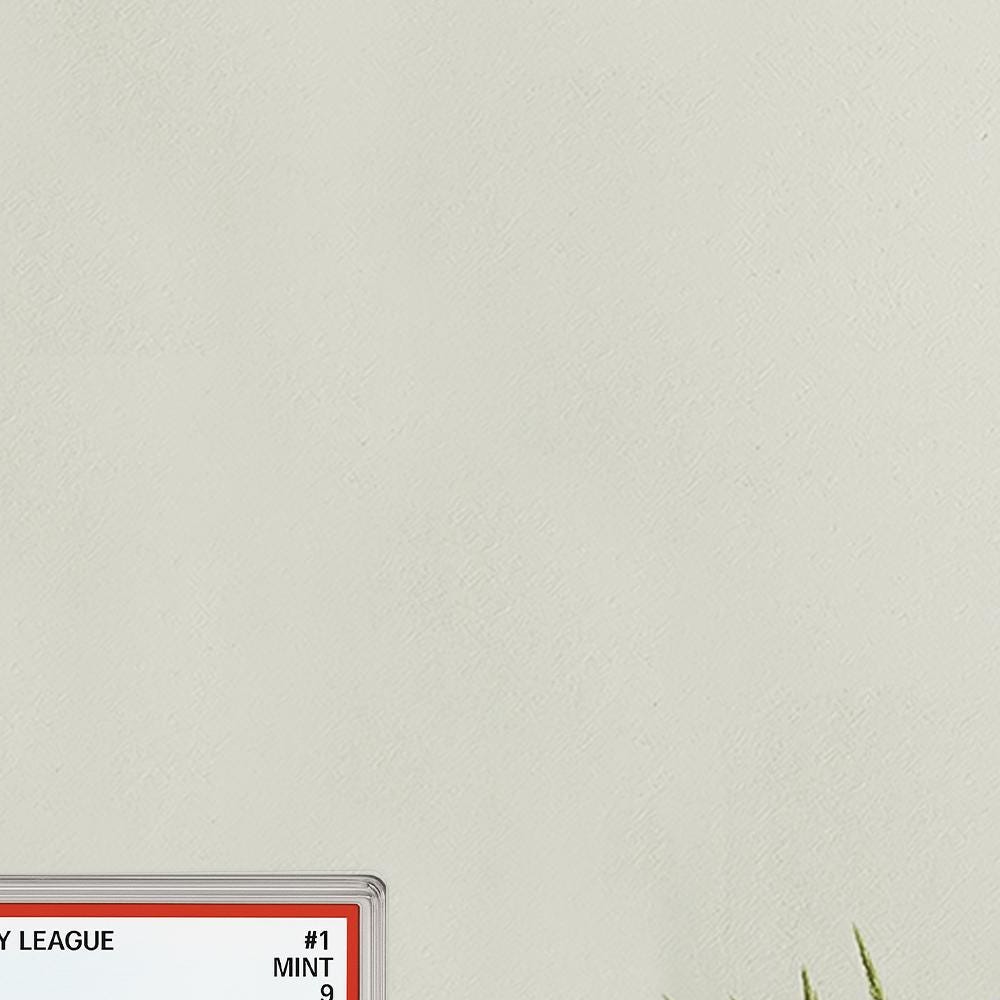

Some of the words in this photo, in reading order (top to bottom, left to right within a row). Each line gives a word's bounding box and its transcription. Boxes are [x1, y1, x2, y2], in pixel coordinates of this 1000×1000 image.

[19, 930, 114, 951] LEAGUE
[304, 930, 330, 951] #1
[273, 957, 334, 978] MINT
